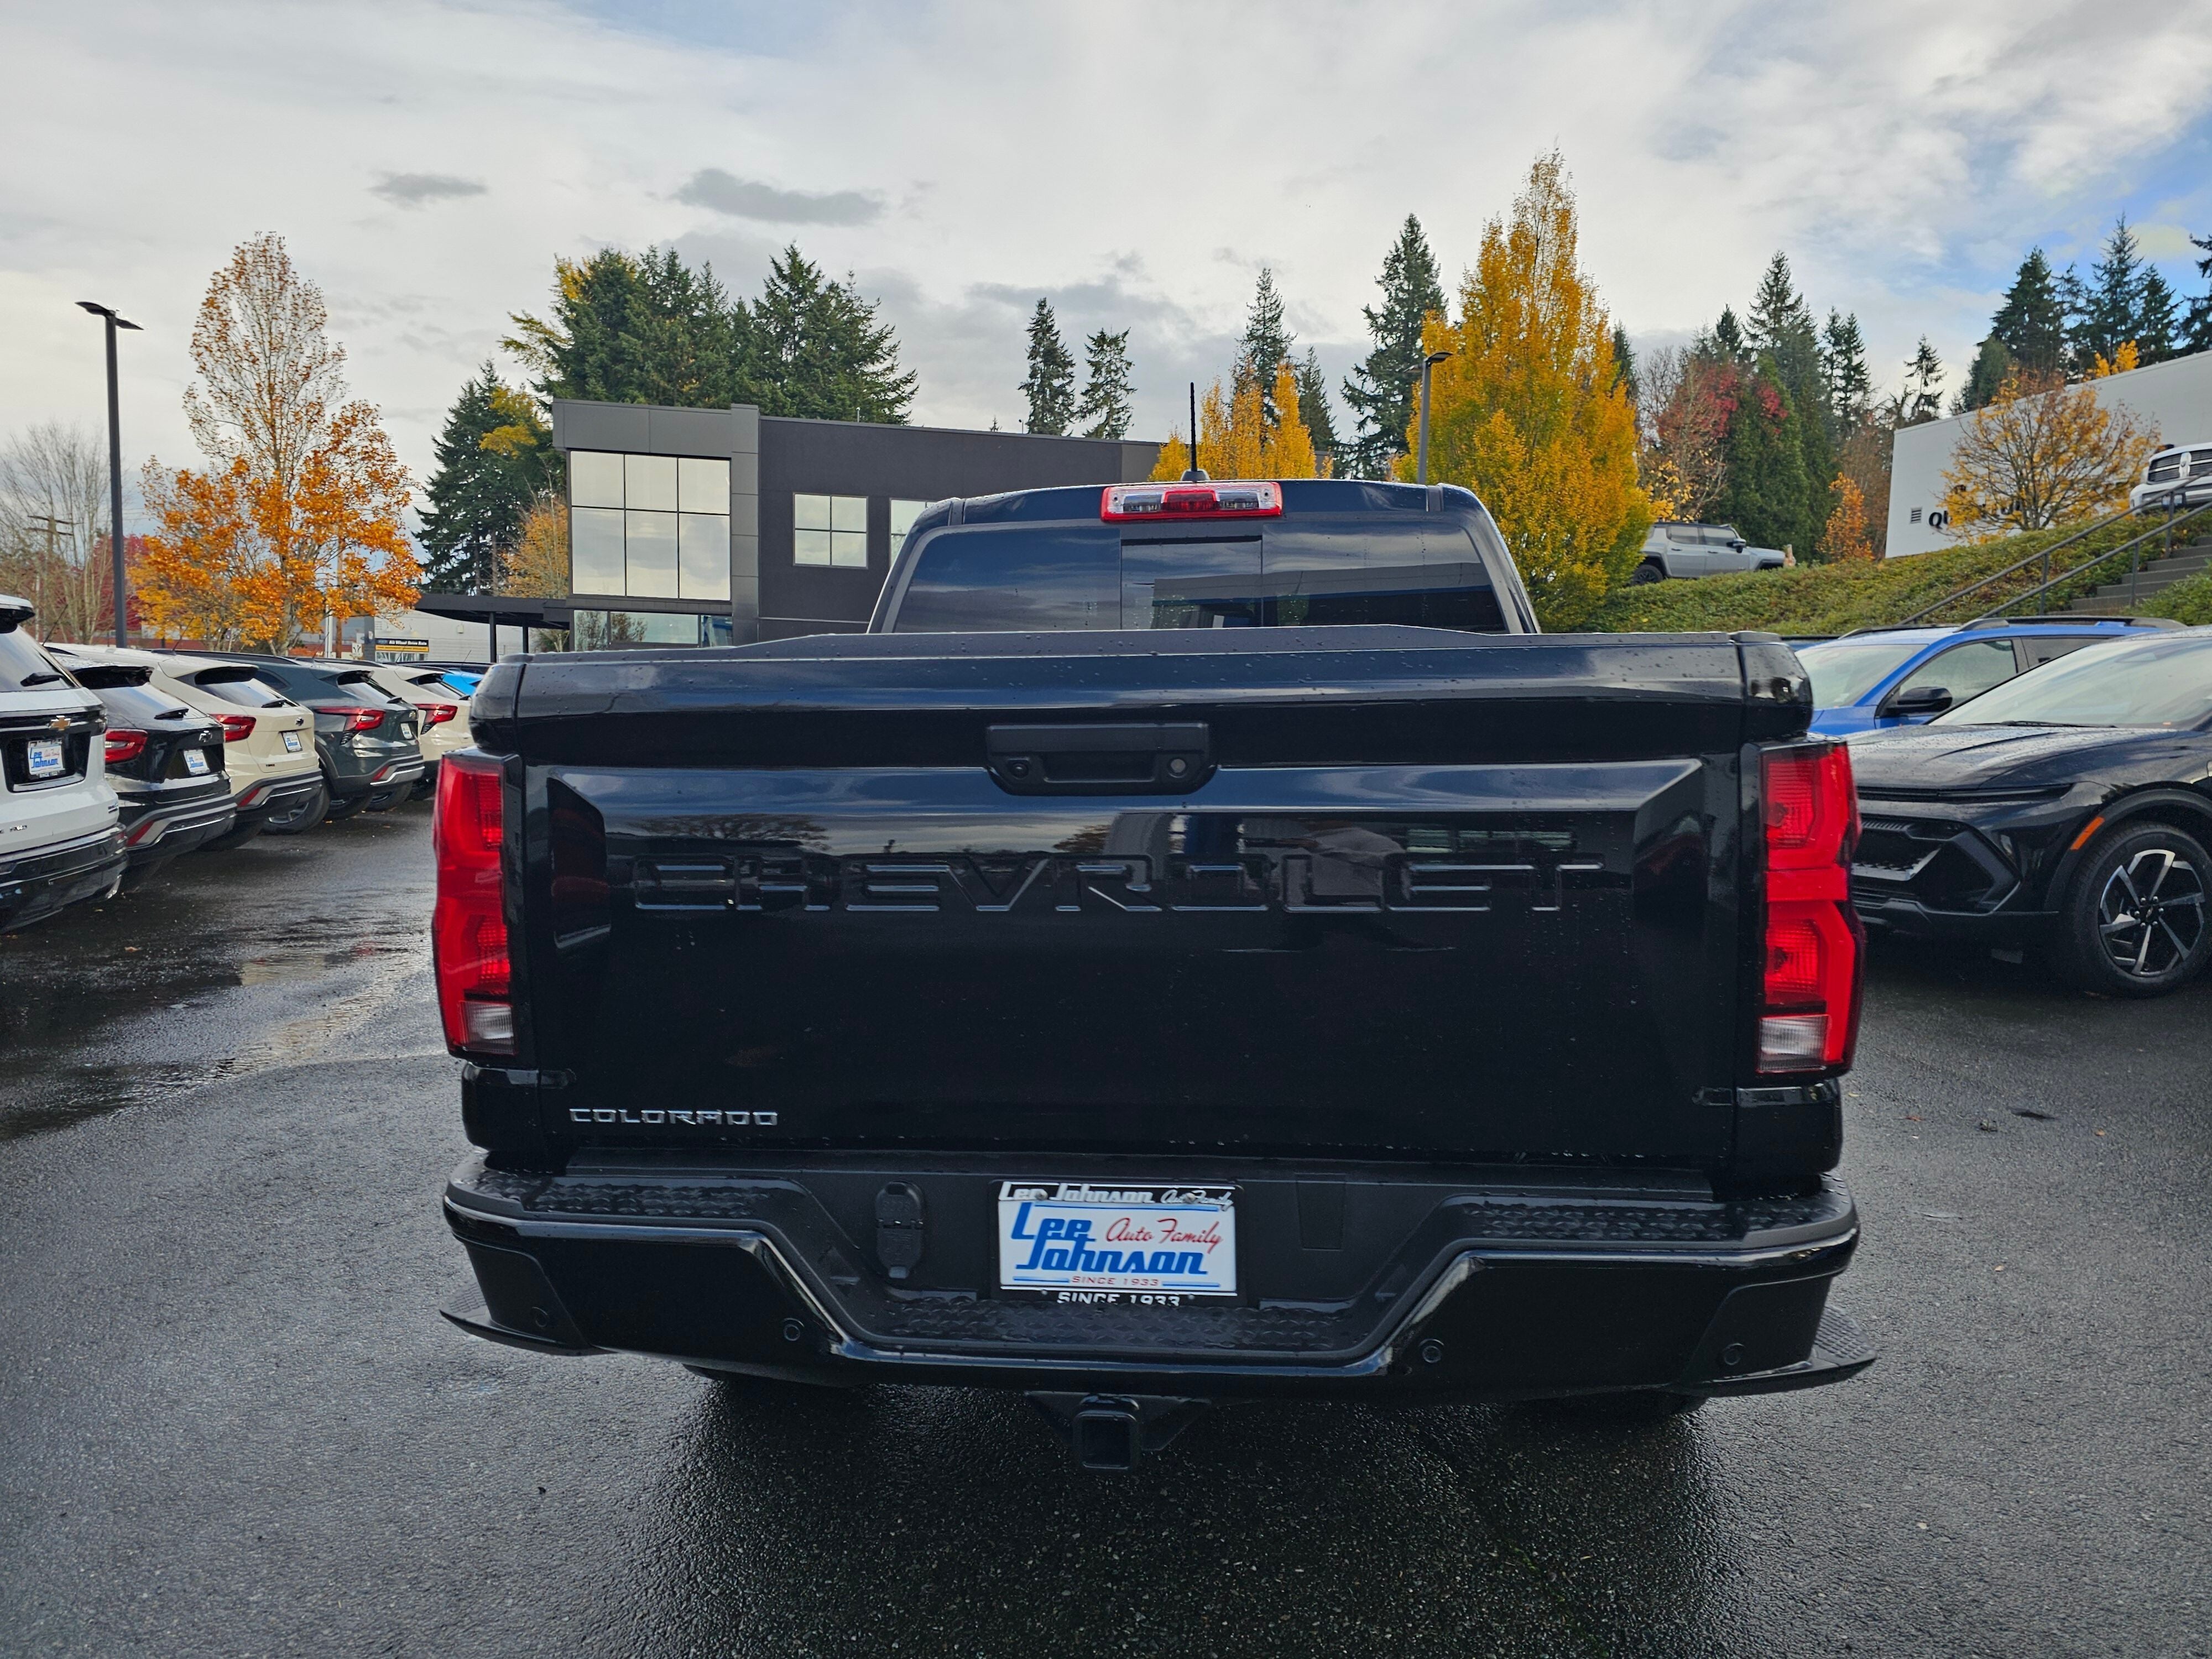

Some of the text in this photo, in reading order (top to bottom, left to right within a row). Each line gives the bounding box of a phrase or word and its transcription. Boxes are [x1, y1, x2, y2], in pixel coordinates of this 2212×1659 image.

[633, 853, 1604, 912] CHEVROLET
[569, 1108, 778, 1126] COLORADO
[1049, 1183, 1155, 1204] Johnson
[1011, 1202, 1097, 1242] Lee
[1105, 1217, 1223, 1254] Auto Family
[1015, 1237, 1208, 1275] Johnson
[1072, 1275, 1159, 1286] SINCE 1933
[1057, 1291, 1120, 1305] SINCE
